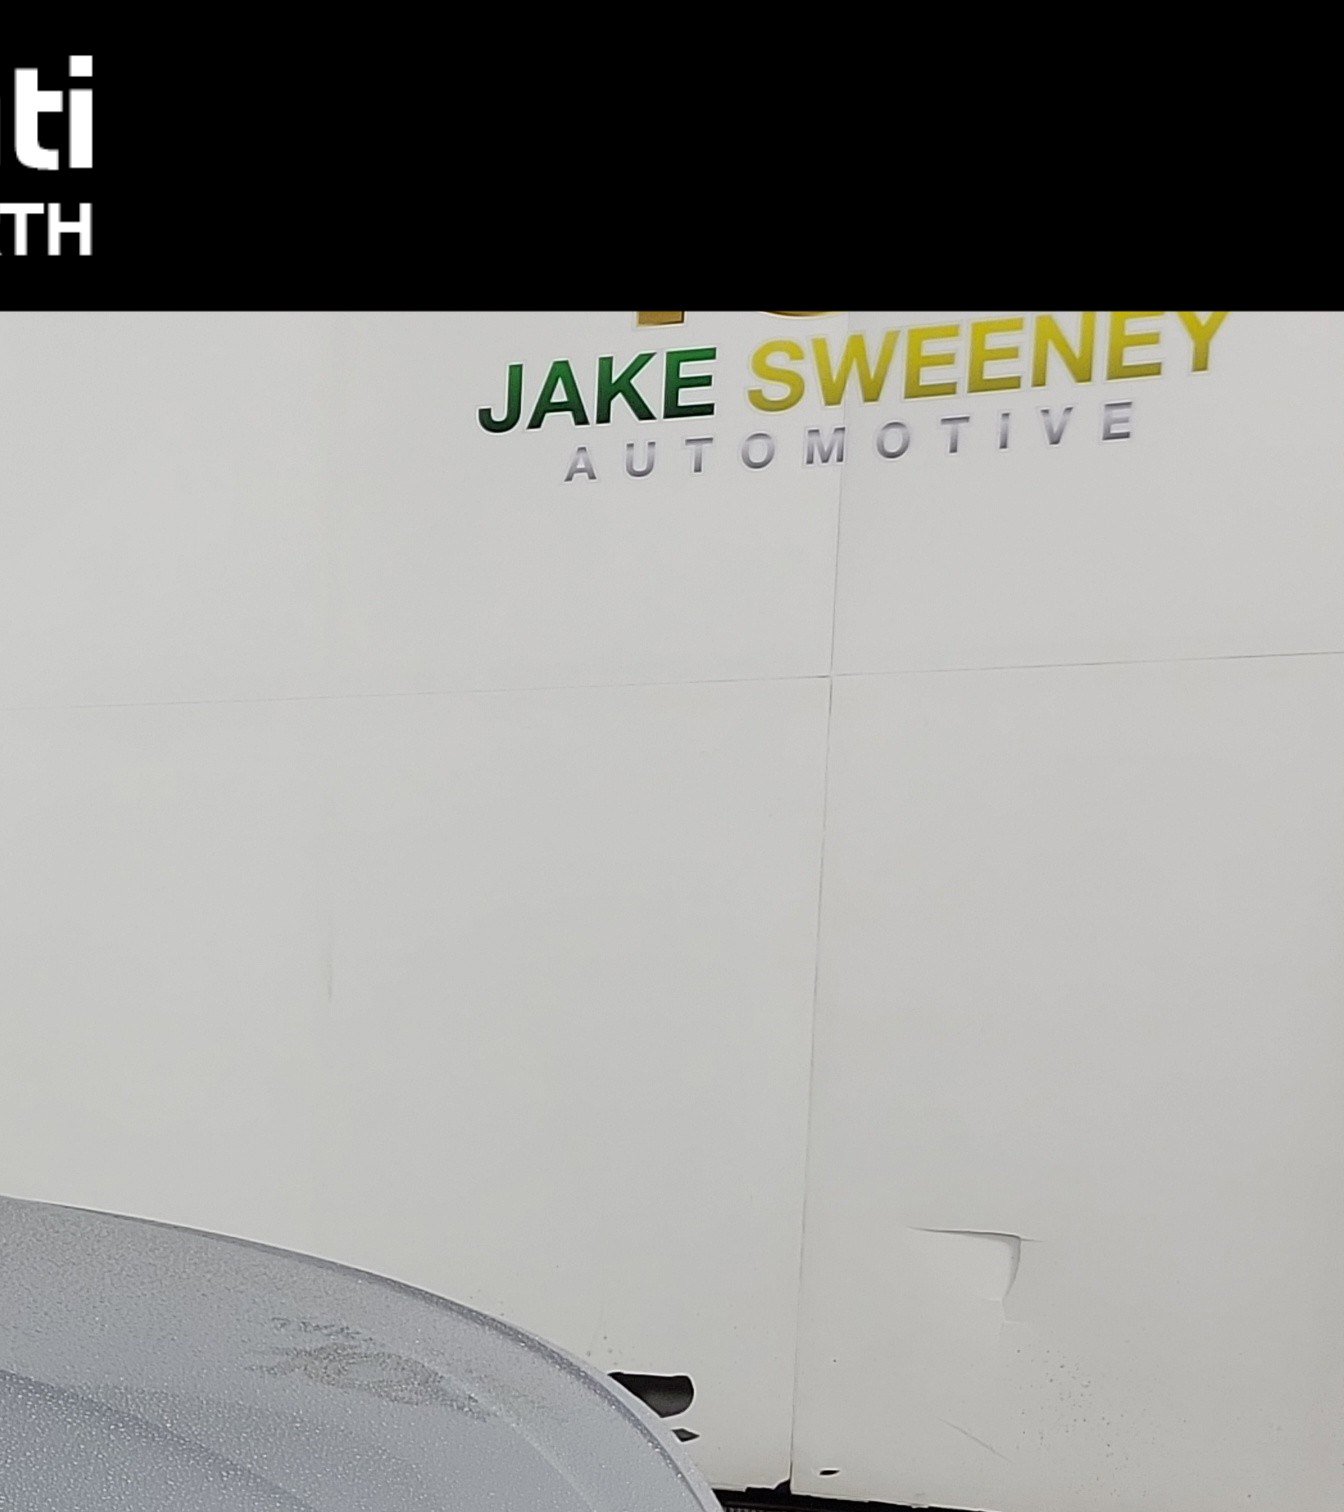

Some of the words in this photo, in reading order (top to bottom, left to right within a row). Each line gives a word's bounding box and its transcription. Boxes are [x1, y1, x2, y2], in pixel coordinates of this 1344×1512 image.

[478, 346, 717, 433] JAKE
[748, 312, 1229, 412] SWEENEY
[564, 401, 1134, 483] AUTOMOTIVE
